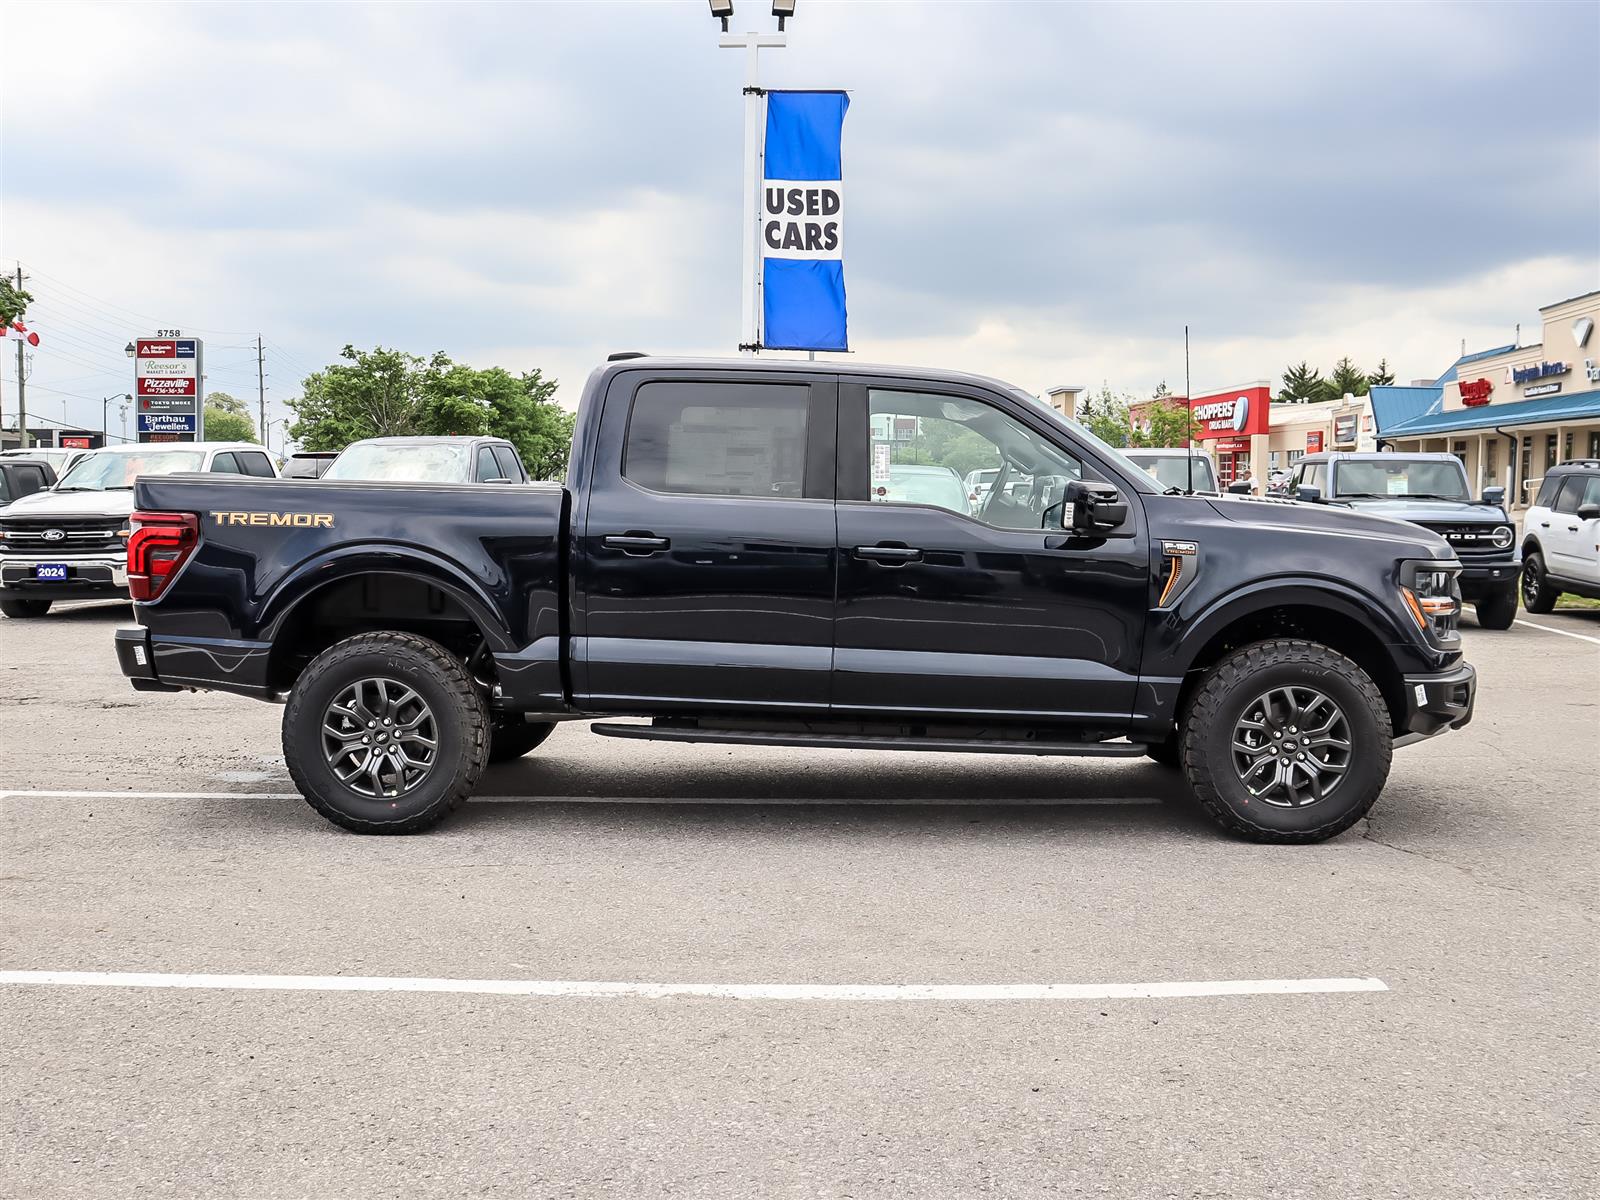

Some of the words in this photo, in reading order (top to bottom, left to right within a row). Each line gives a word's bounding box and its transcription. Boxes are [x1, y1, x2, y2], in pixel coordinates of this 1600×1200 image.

[766, 188, 840, 216] USED
[764, 221, 838, 251] CARS
[144, 360, 187, 369] Reesor's
[144, 379, 190, 388] Pizzaville
[144, 415, 186, 424] Barthau
[149, 422, 189, 432] Jewellers
[209, 511, 335, 529] TREMOR
[1164, 543, 1196, 551] F-150
[38, 567, 65, 577] 2024
